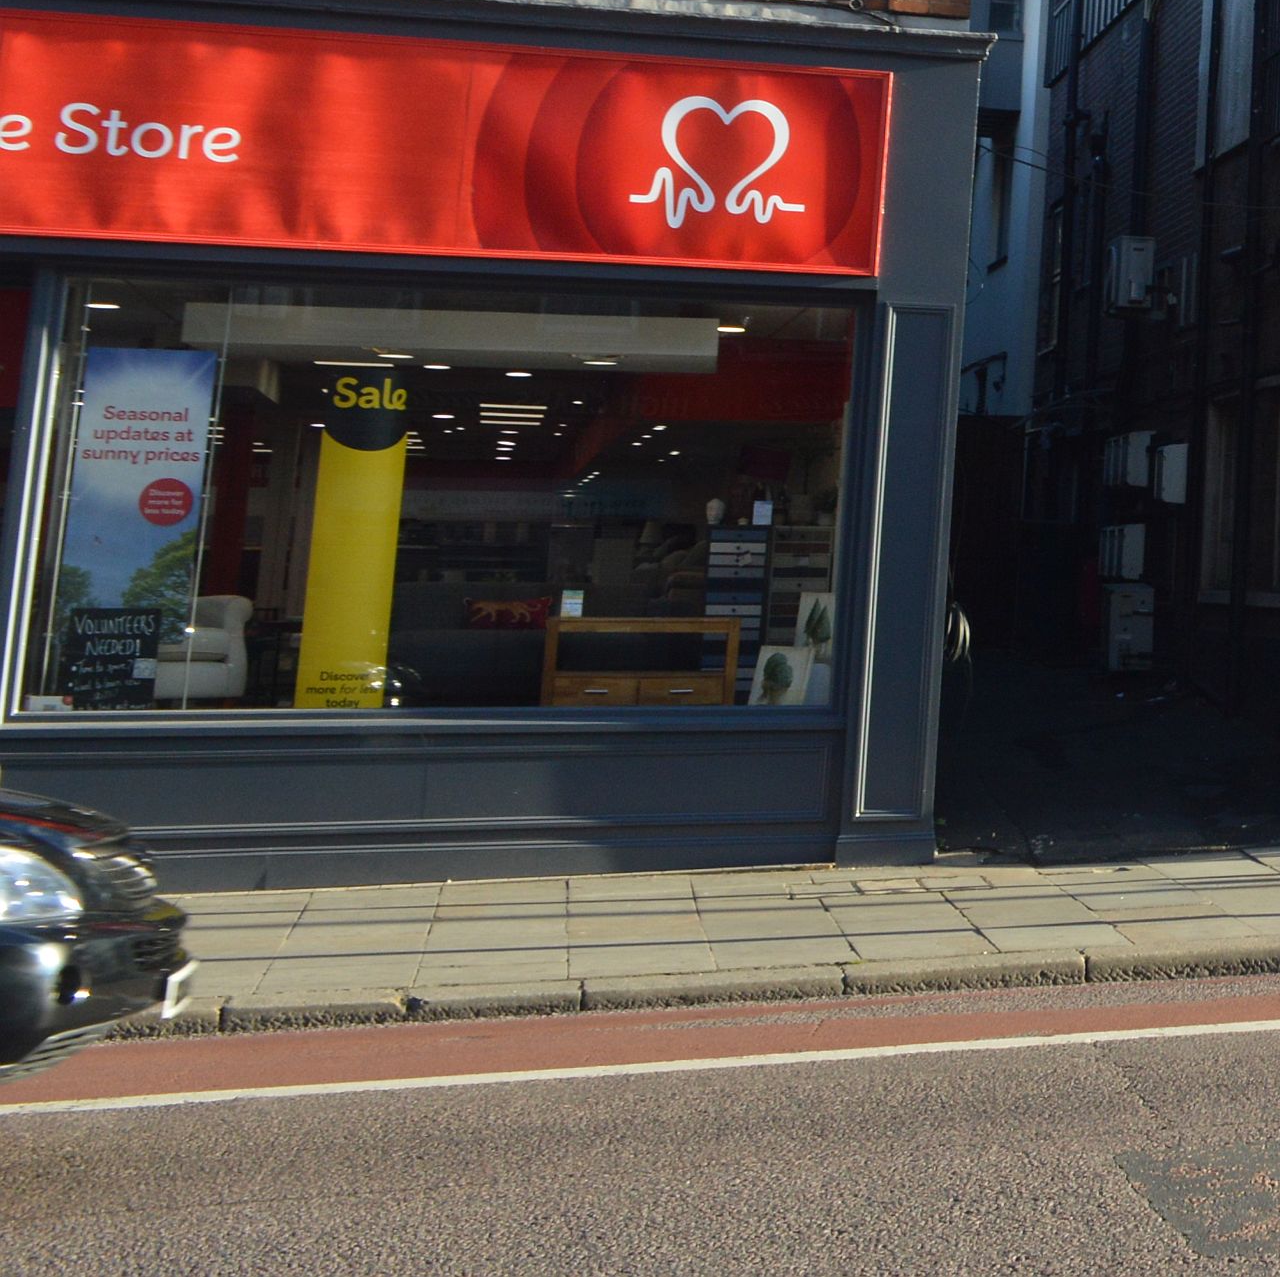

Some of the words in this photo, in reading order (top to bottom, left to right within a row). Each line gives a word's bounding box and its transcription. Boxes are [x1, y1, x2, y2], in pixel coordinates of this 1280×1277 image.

[54, 102, 242, 163] Store
[333, 376, 408, 411] Sale
[103, 405, 189, 422] Seasonal
[93, 426, 170, 444] updates
[174, 429, 194, 442] at
[82, 448, 140, 465] sunny
[144, 448, 201, 465] prices
[74, 614, 155, 635] VOLUNTEERS
[85, 638, 140, 656] NEEDED!
[339, 685, 357, 694] for
[326, 697, 360, 708] today
